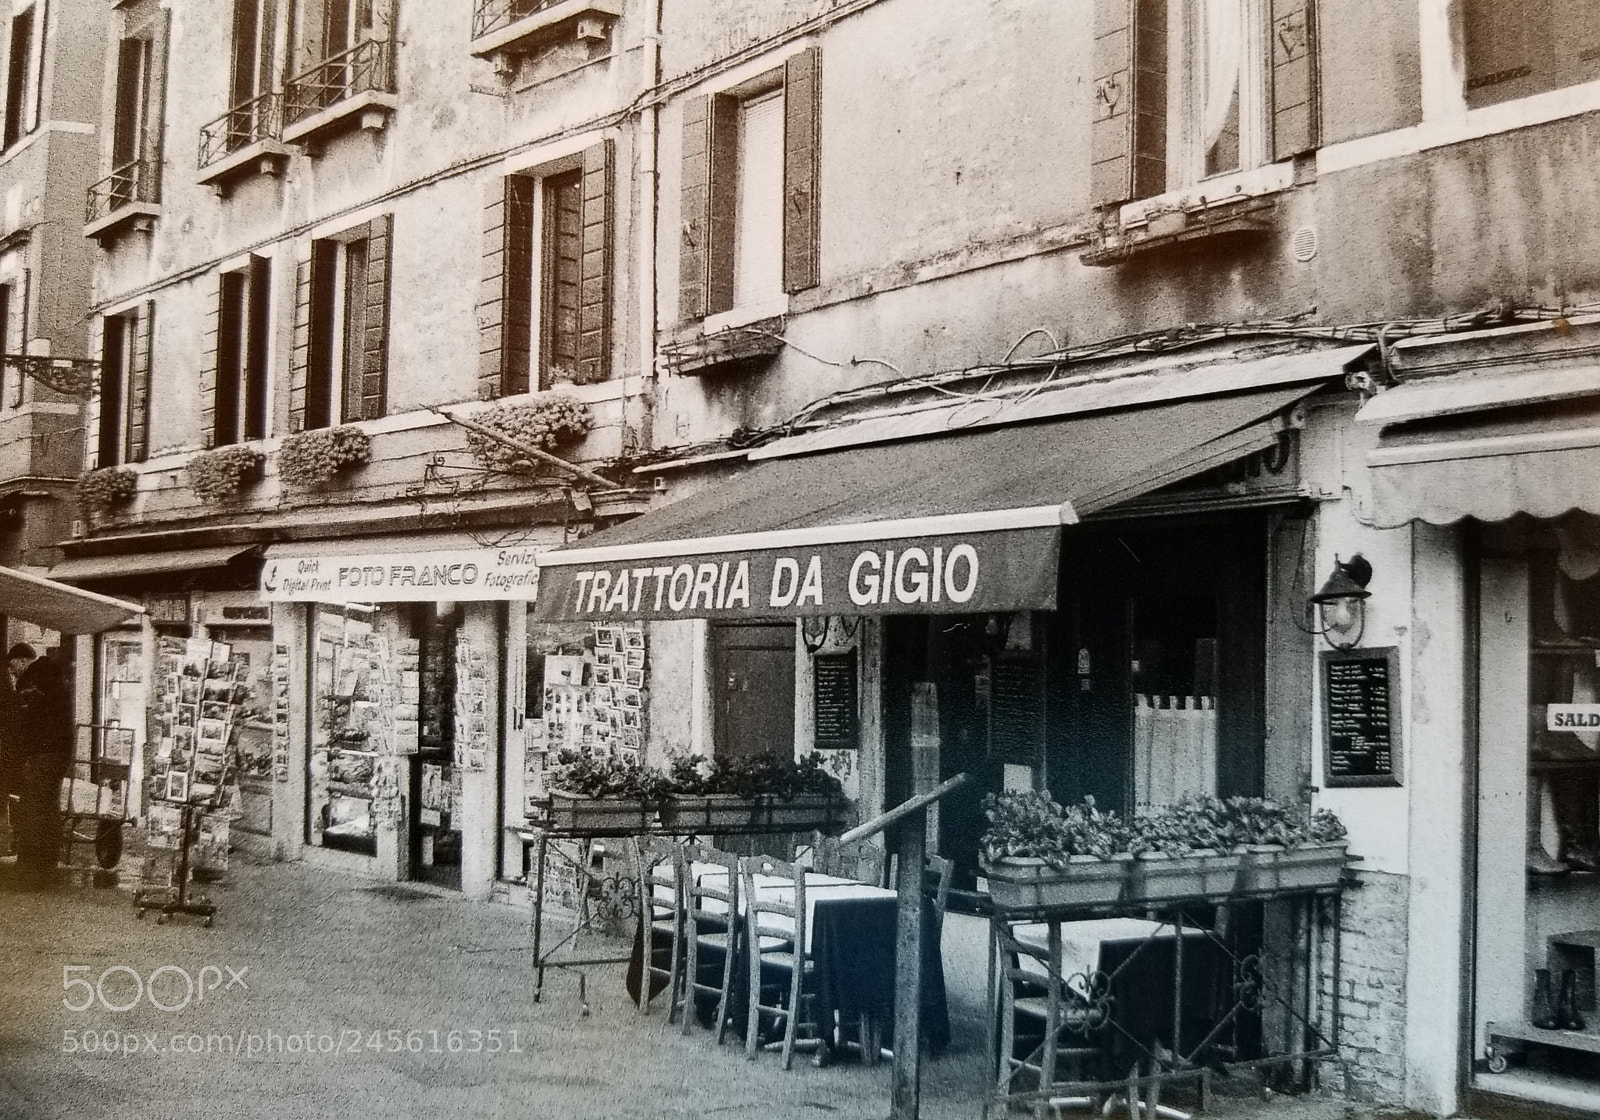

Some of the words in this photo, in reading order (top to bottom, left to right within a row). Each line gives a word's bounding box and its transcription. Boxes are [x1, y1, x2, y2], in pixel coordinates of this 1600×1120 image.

[339, 567, 385, 587] FOTO
[389, 563, 478, 586] FRANCO
[575, 560, 750, 613] TRATTORIA
[770, 555, 823, 607] DA
[848, 543, 979, 605] GIGIO
